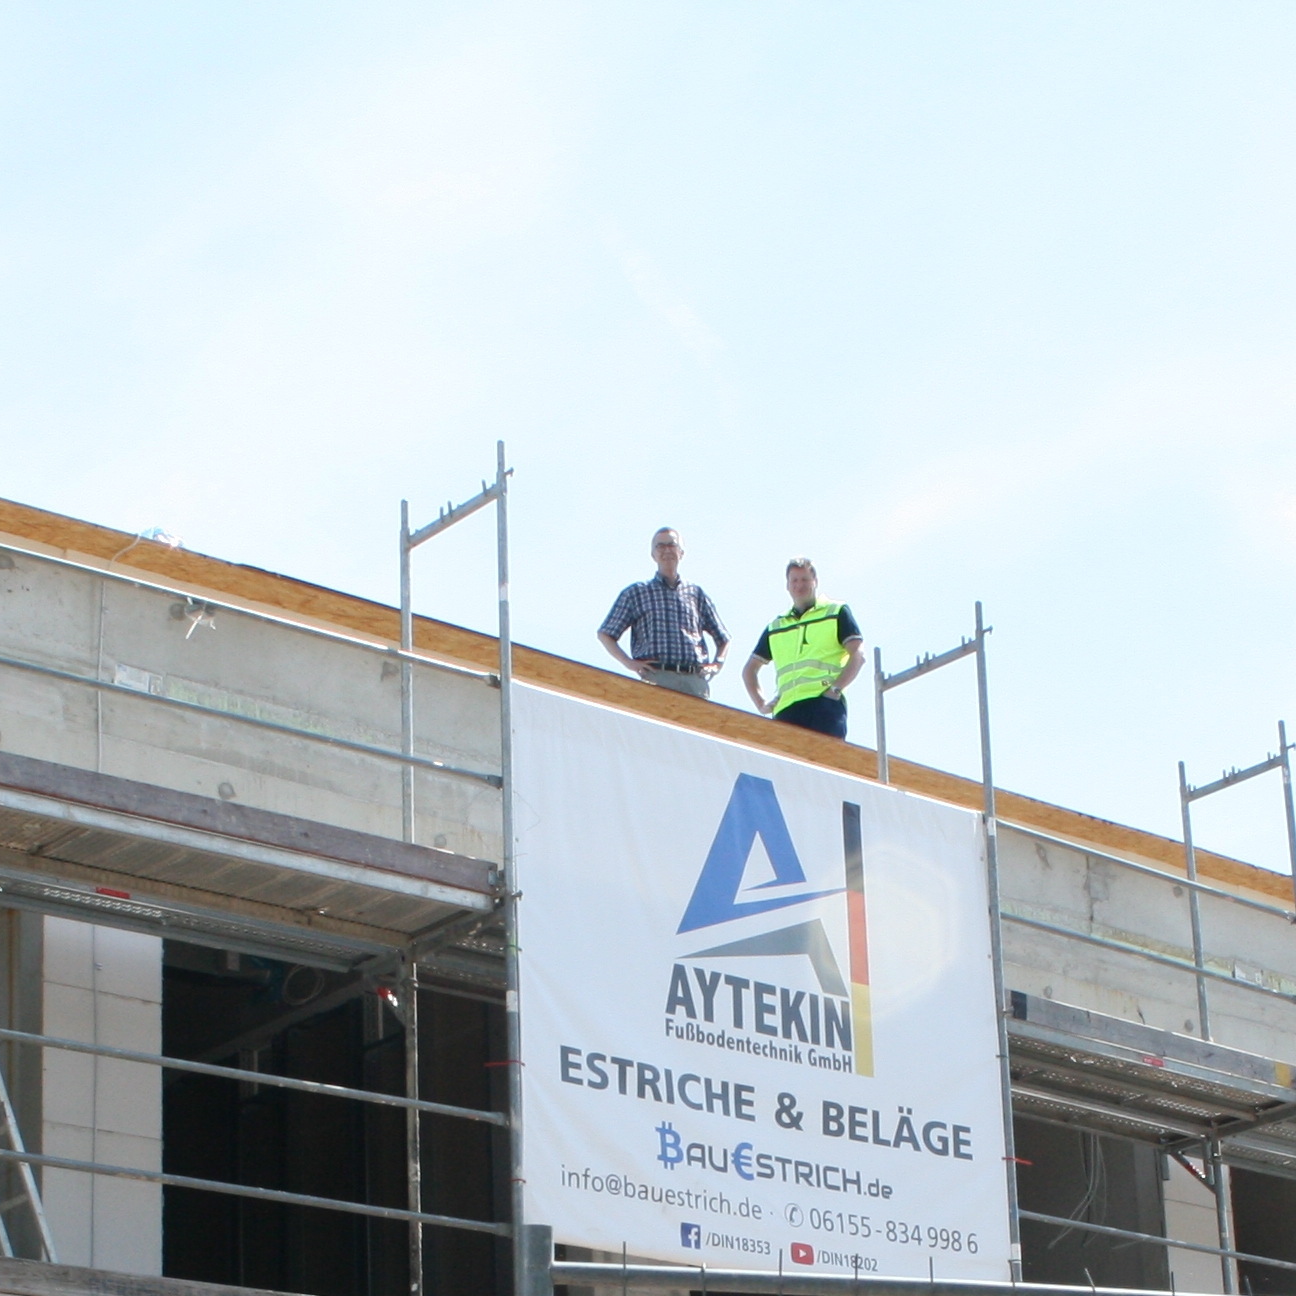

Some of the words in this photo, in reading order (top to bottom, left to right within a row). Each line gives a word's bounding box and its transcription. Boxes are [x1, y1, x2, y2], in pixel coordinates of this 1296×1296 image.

[665, 962, 853, 1052] AYTEKIN
[665, 1018, 802, 1064] Fußbodentechnik
[808, 1049, 853, 1074] GmbH
[560, 1044, 756, 1122] ESTRICHE
[774, 1092, 804, 1131] &
[822, 1100, 973, 1161] BELÄGE
[561, 1164, 762, 1220] info@bauestrich.de
